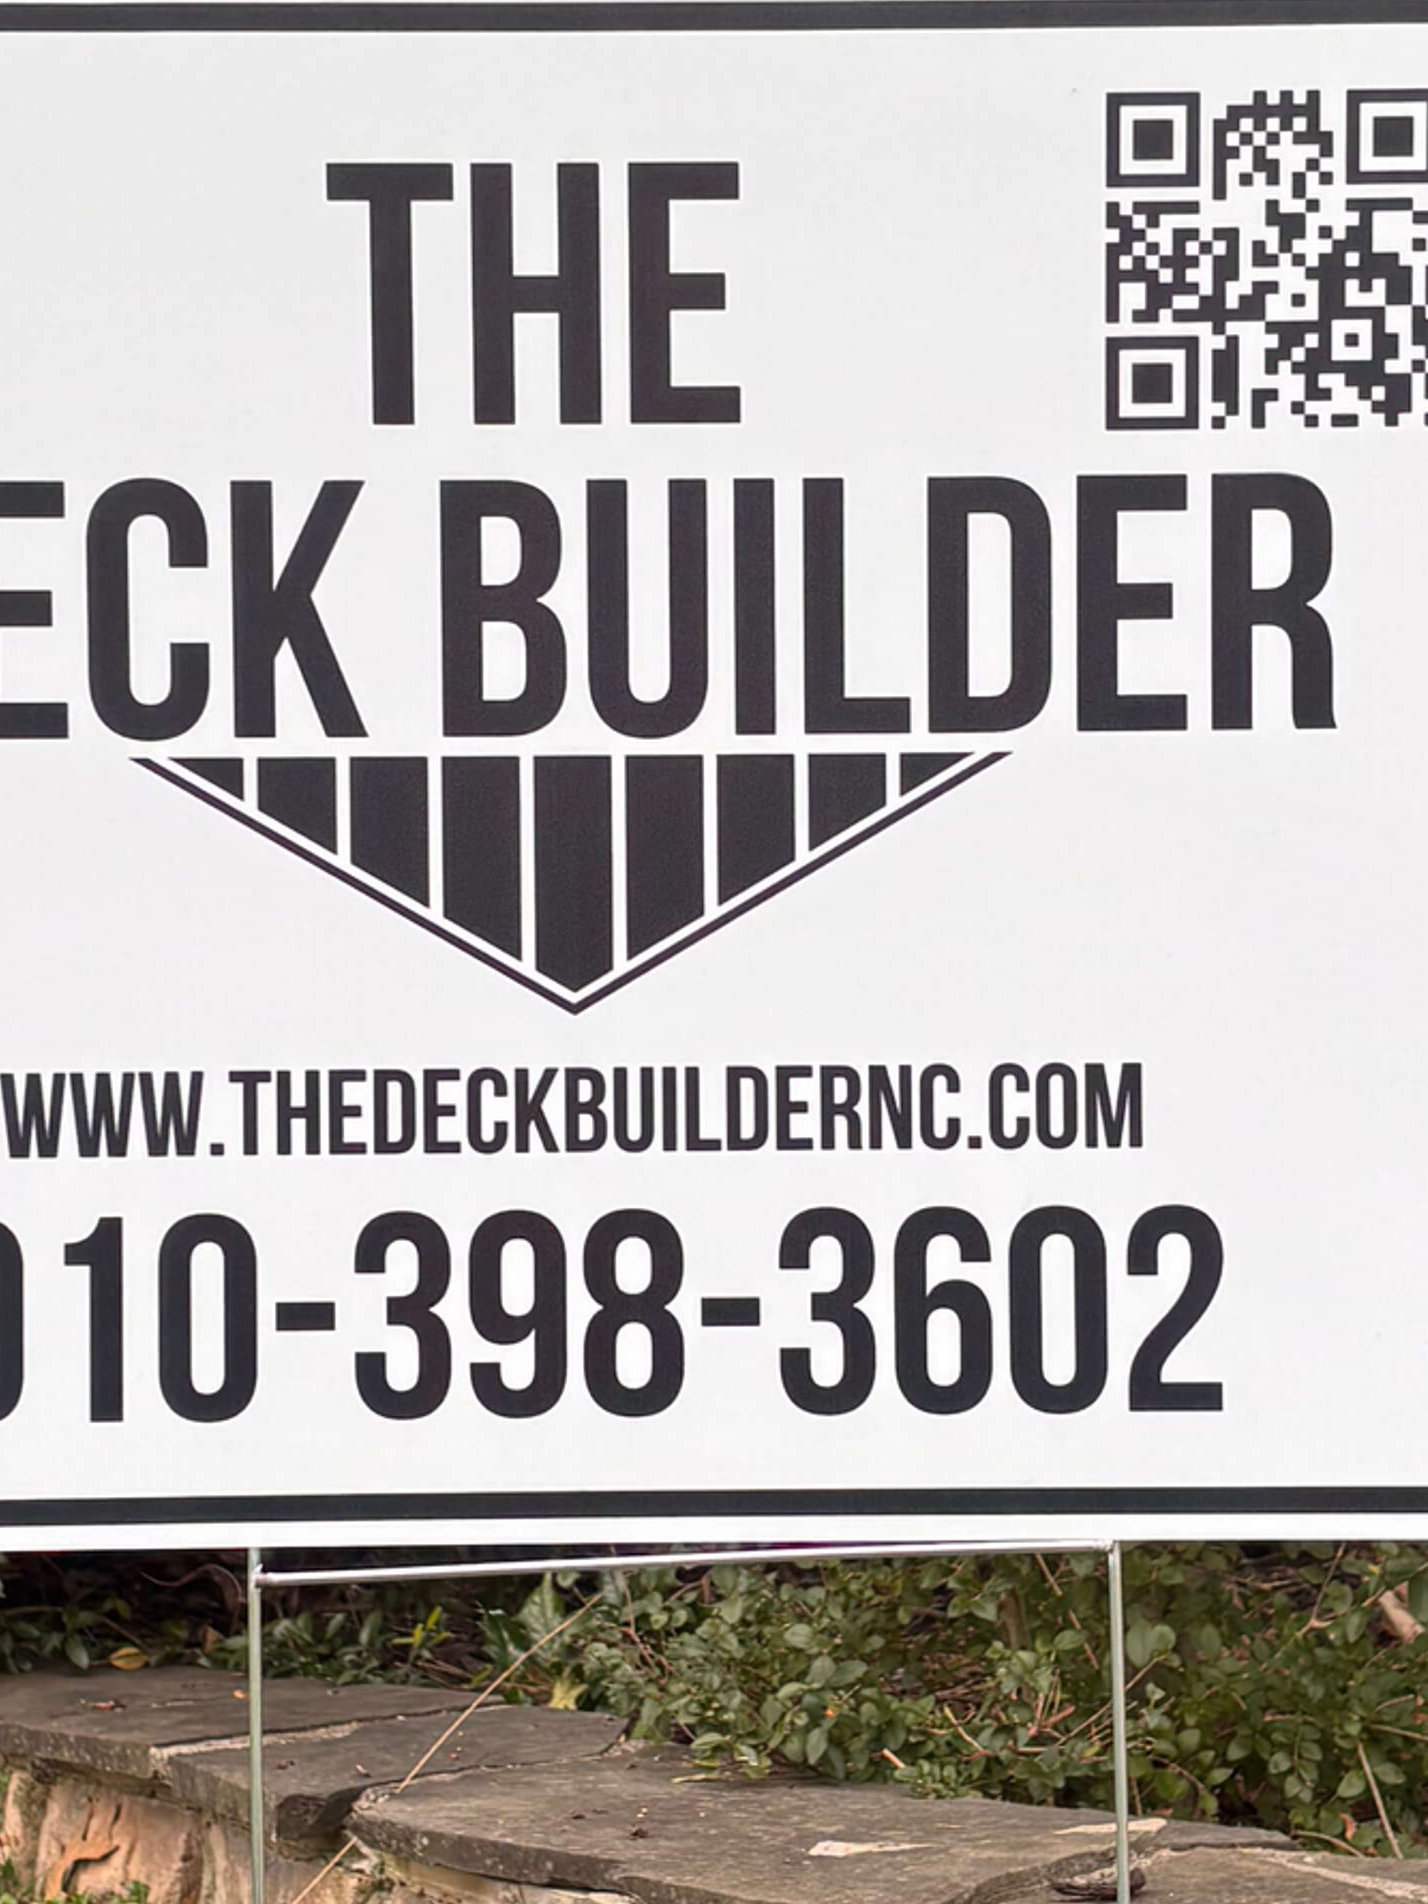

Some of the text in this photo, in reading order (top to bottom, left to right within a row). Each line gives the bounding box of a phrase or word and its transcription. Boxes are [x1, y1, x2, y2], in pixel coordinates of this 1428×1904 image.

[327, 162, 740, 425] THE
[440, 473, 1336, 739] BUILDER
[0, 1063, 1142, 1158] WWW.THEDECKBUILDERNC.COM
